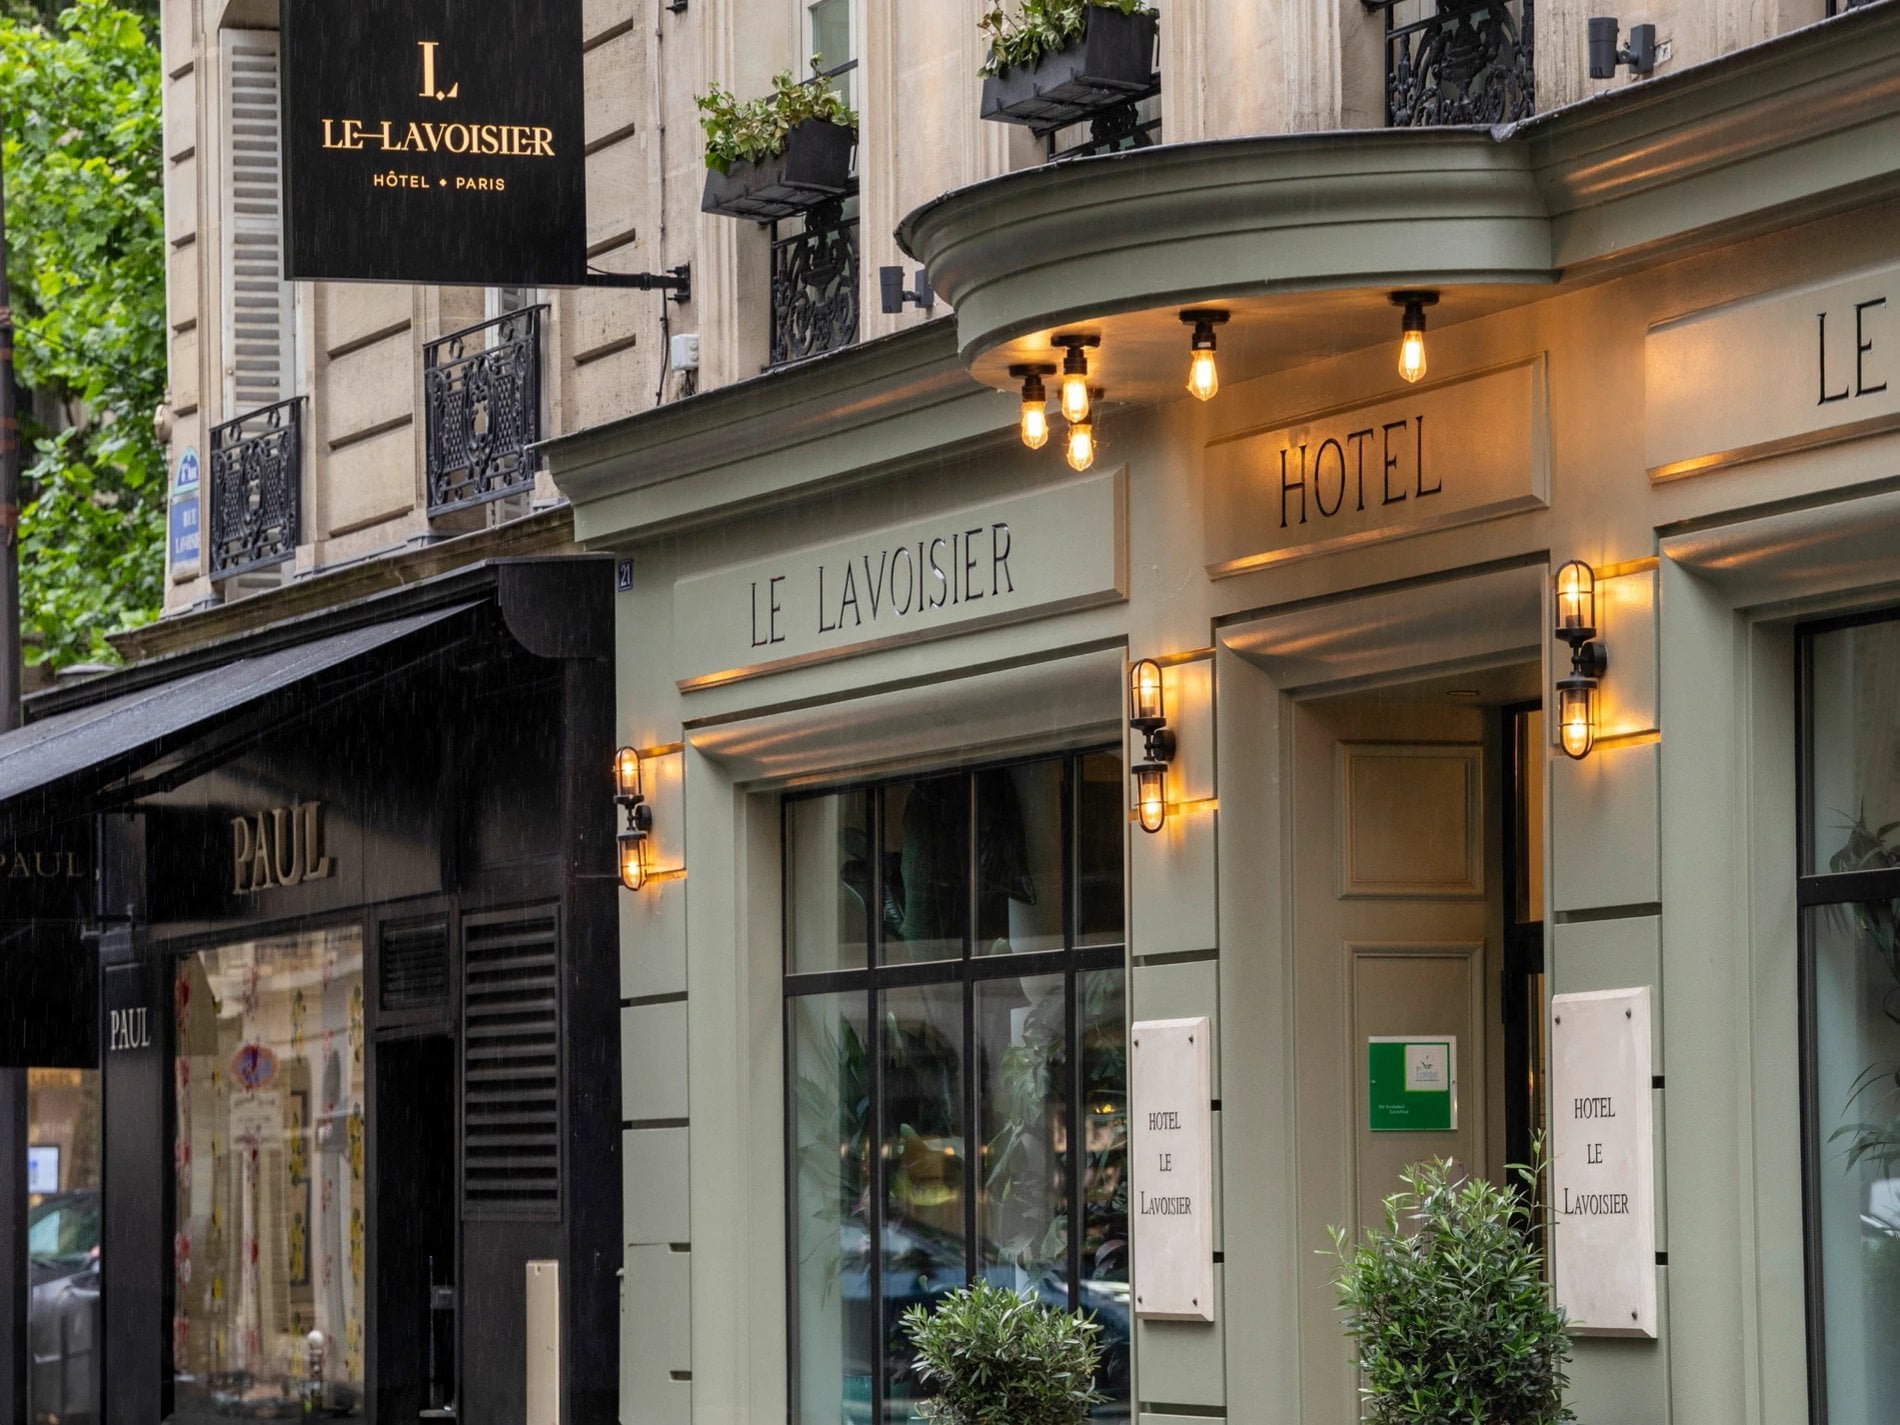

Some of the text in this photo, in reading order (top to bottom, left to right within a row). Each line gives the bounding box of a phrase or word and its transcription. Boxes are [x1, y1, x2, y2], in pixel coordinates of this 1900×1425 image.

[417, 41, 459, 102] L
[321, 119, 556, 157] LE LAVOISIER
[373, 169, 505, 191] HÔTEL PARIS
[1816, 296, 1888, 406] LE
[1280, 415, 1442, 528] HOTEL
[620, 562, 630, 587] 21
[751, 522, 1014, 648] LE LAVOISIER
[230, 801, 330, 895] PAUL
[110, 1007, 152, 1051] PAUL
[1148, 1111, 1181, 1131] HOTEL
[1574, 1097, 1616, 1119] HOTEL
[1159, 1153, 1172, 1172] LE
[1587, 1143, 1603, 1164] LE
